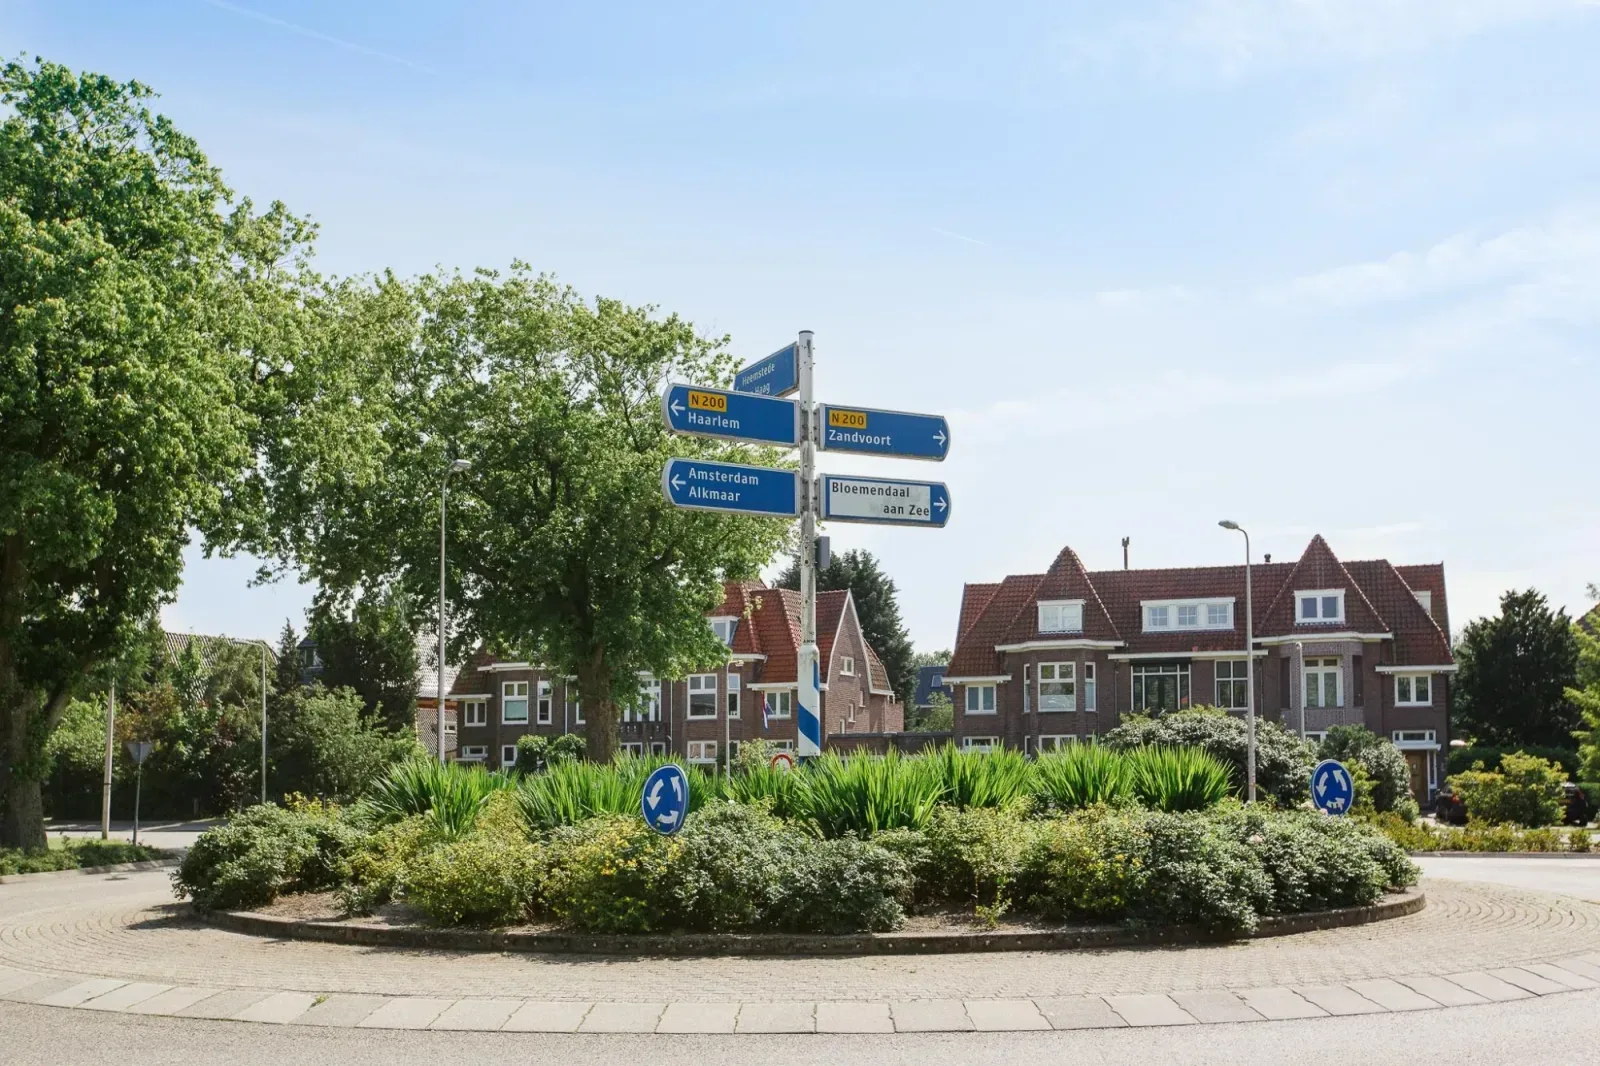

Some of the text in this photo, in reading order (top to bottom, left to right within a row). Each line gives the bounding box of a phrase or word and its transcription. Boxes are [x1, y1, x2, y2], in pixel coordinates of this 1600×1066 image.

[742, 363, 775, 386] Heemstede
[702, 395, 725, 409] 200
[688, 411, 740, 430] Haarlem
[842, 414, 865, 426] 200
[828, 429, 892, 446] Zandvoort
[688, 467, 759, 486] Amsterdam
[688, 486, 741, 502] Alkmaar
[832, 481, 910, 498] Bloemendaal
[883, 504, 930, 516] aan Zee
